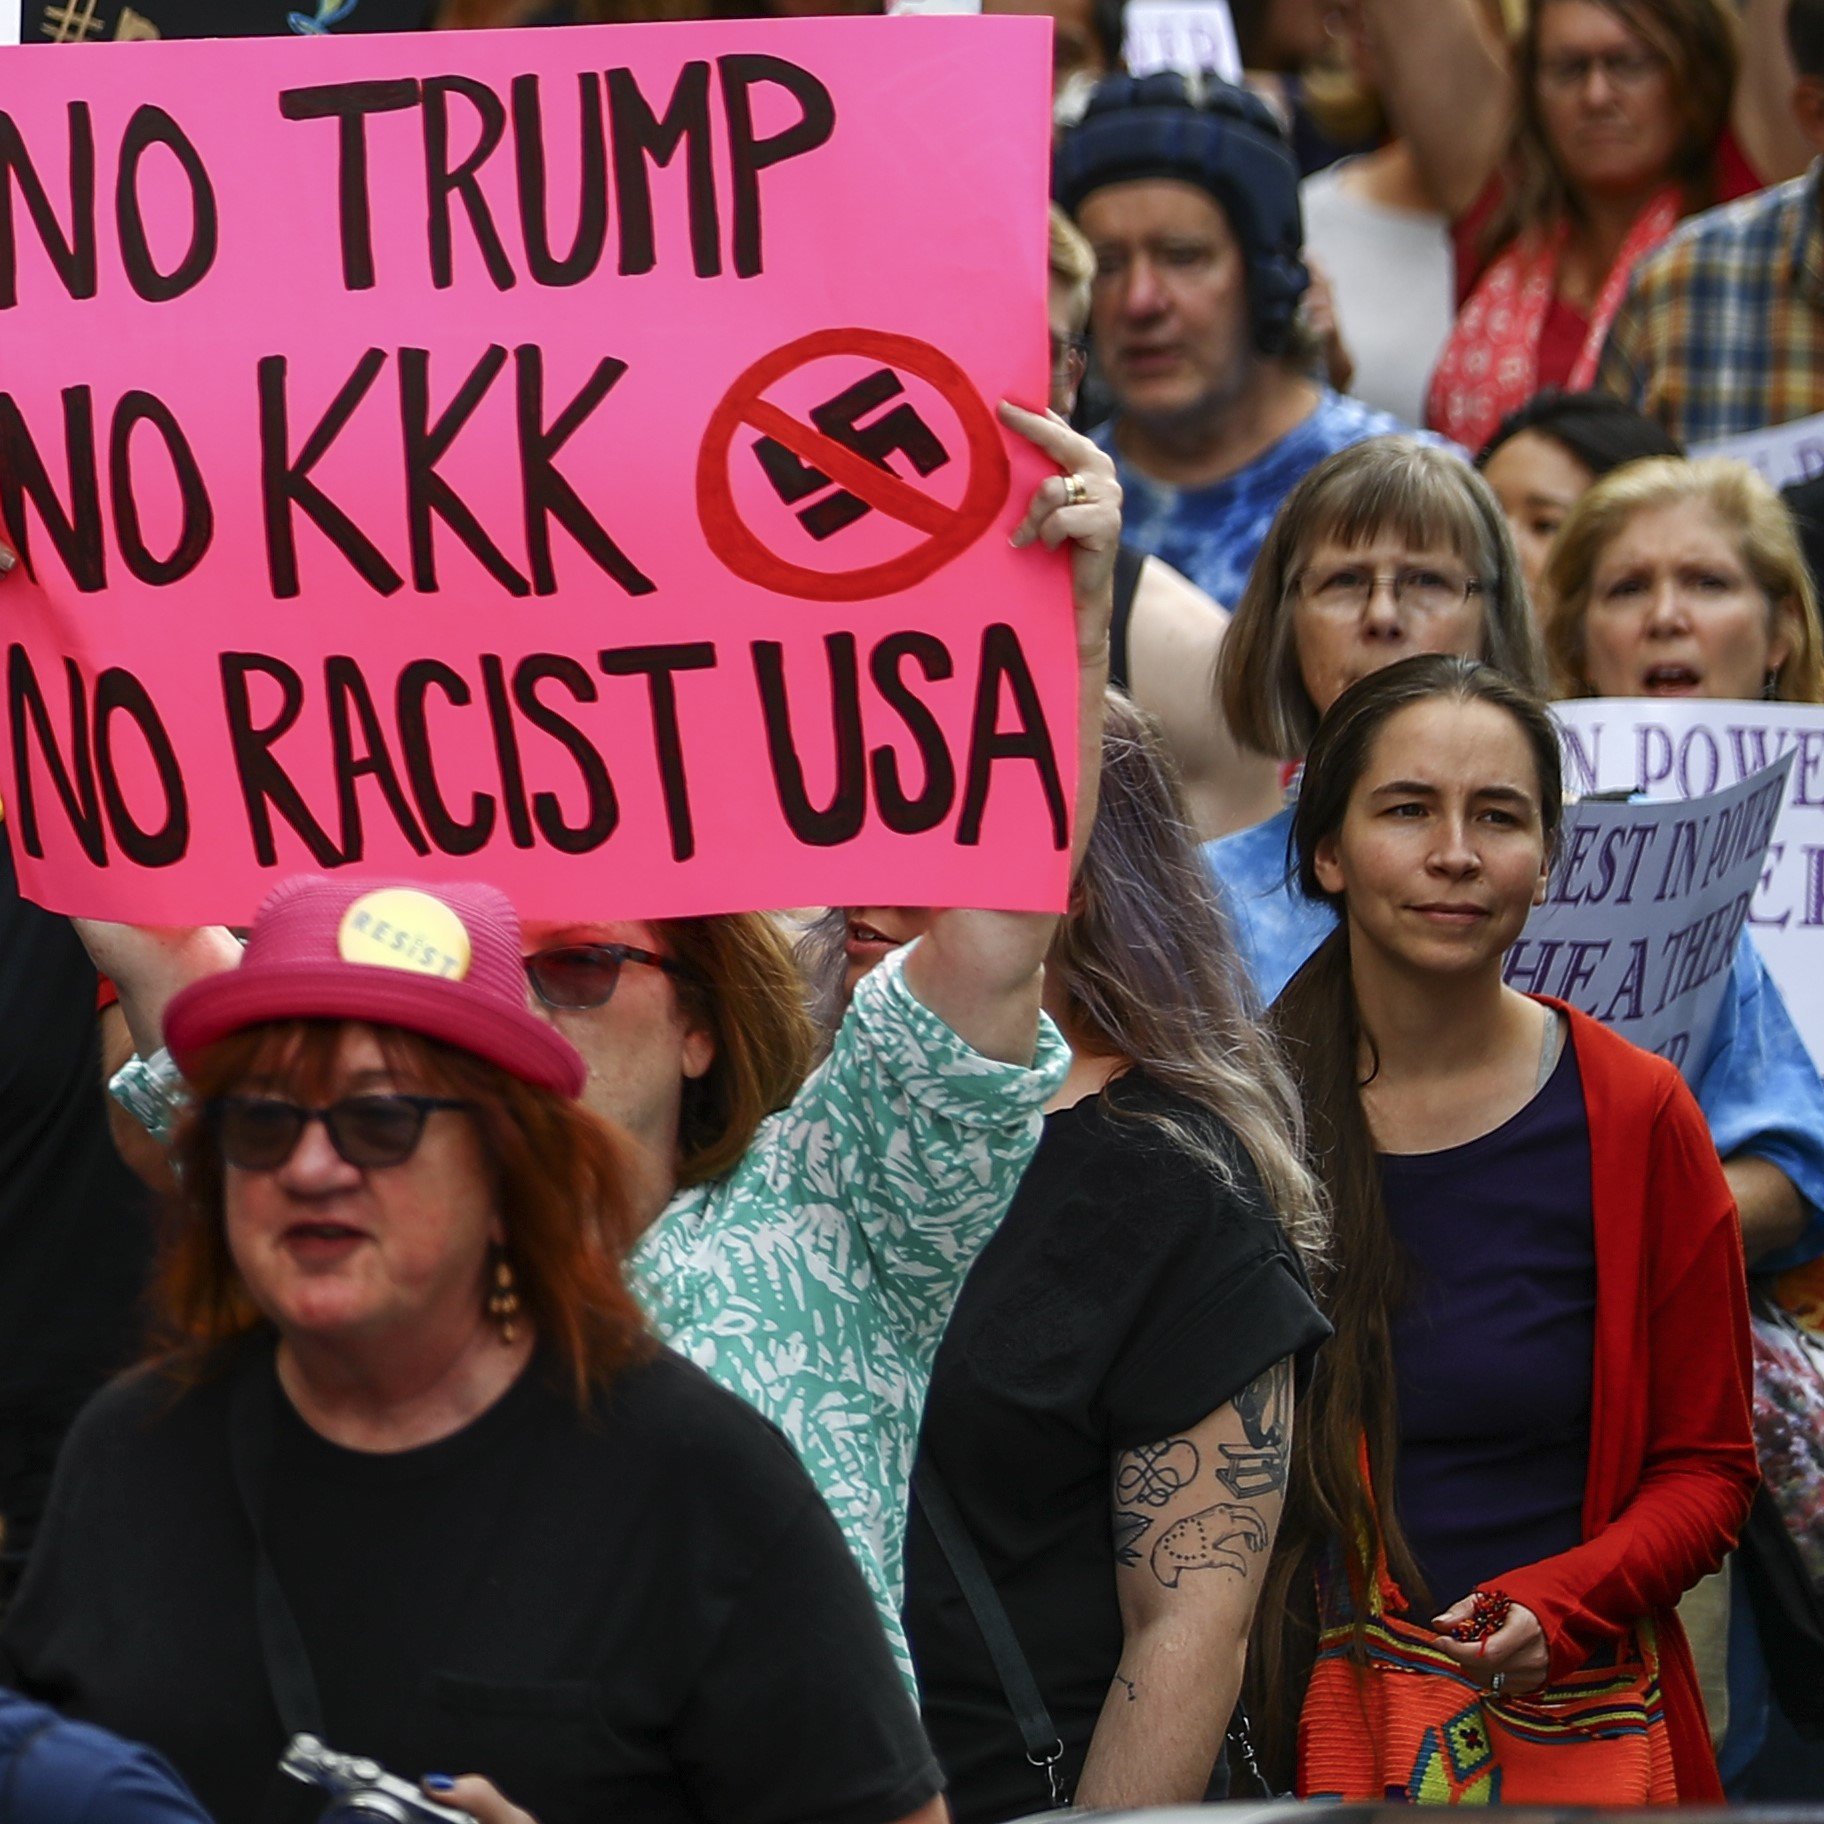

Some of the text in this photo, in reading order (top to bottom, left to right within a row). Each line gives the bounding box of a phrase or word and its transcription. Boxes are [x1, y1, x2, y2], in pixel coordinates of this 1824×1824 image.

[278, 52, 837, 292] TRUMP
[256, 343, 659, 601] KKK
[5, 622, 1072, 872] NO RACIST USA
[1654, 813, 1709, 903] IN
[1701, 772, 1790, 889] POWER
